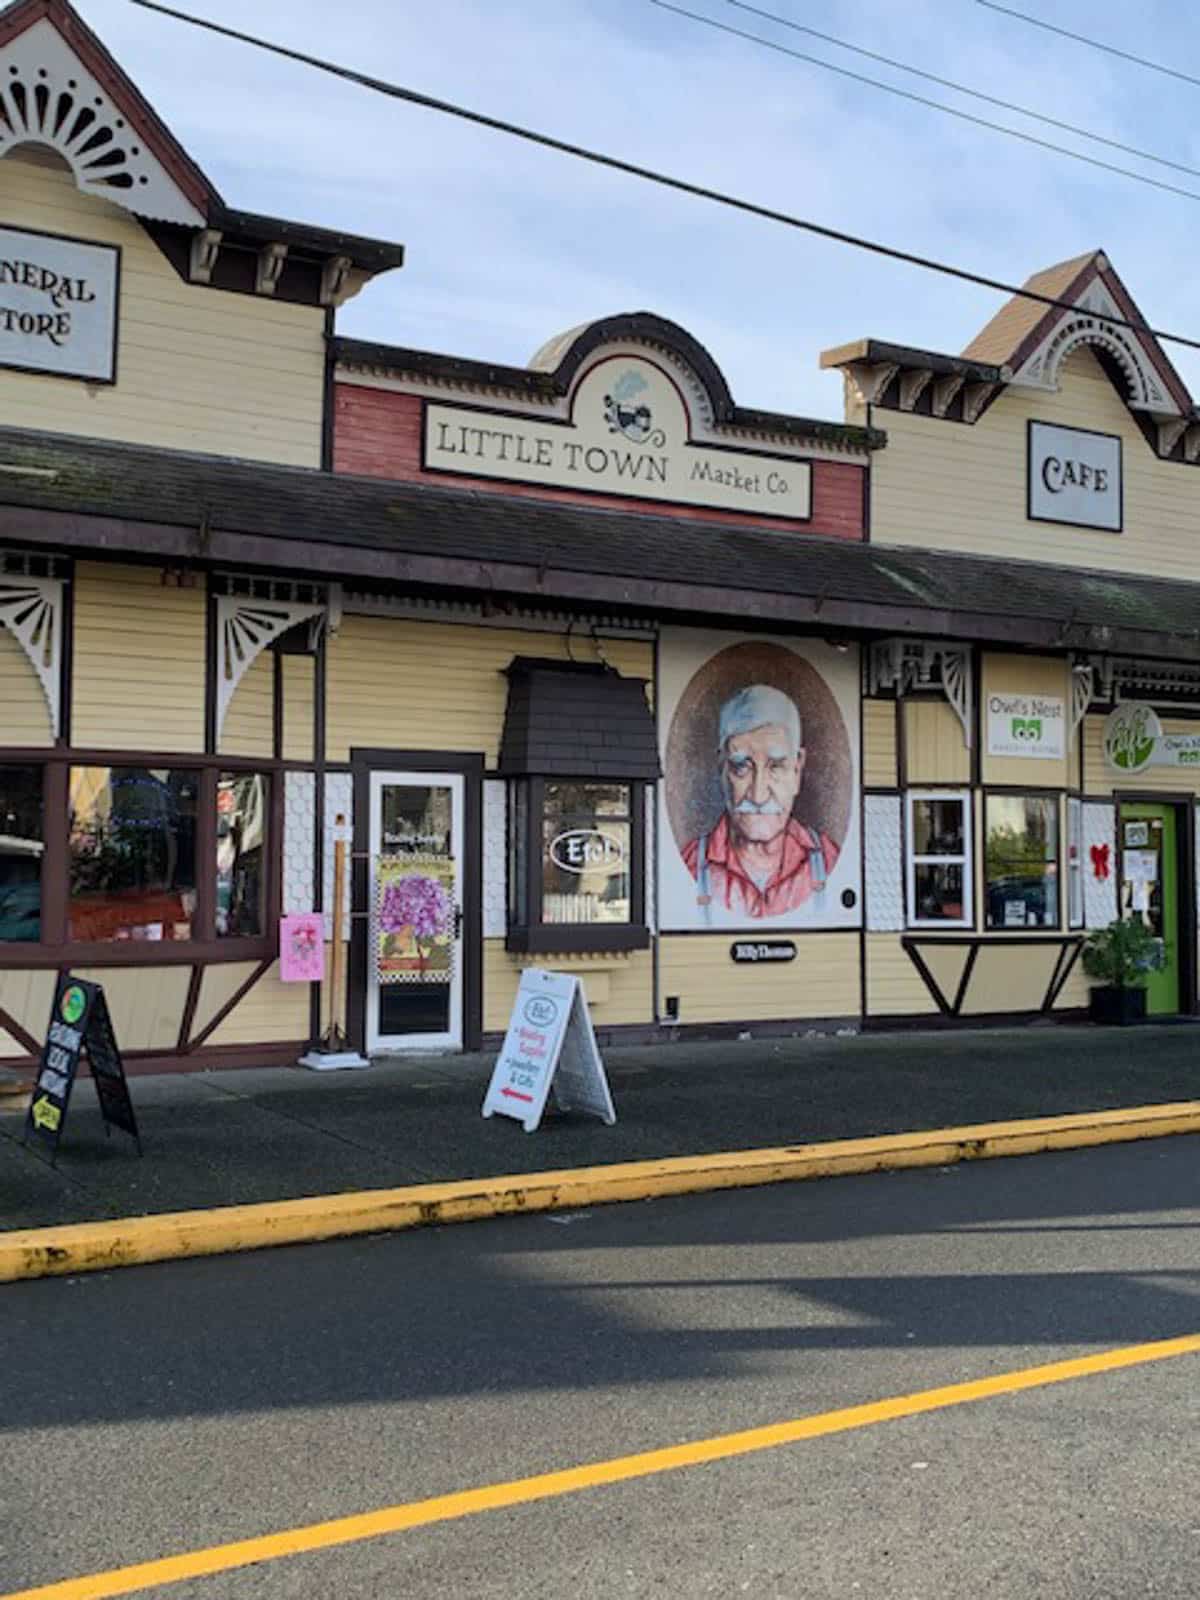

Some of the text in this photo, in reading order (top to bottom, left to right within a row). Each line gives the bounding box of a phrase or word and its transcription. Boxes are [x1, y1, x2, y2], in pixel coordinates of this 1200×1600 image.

[436, 421, 669, 482] LITTLE TOWN
[690, 461, 762, 494] Market
[1042, 455, 1108, 494] CAFE
